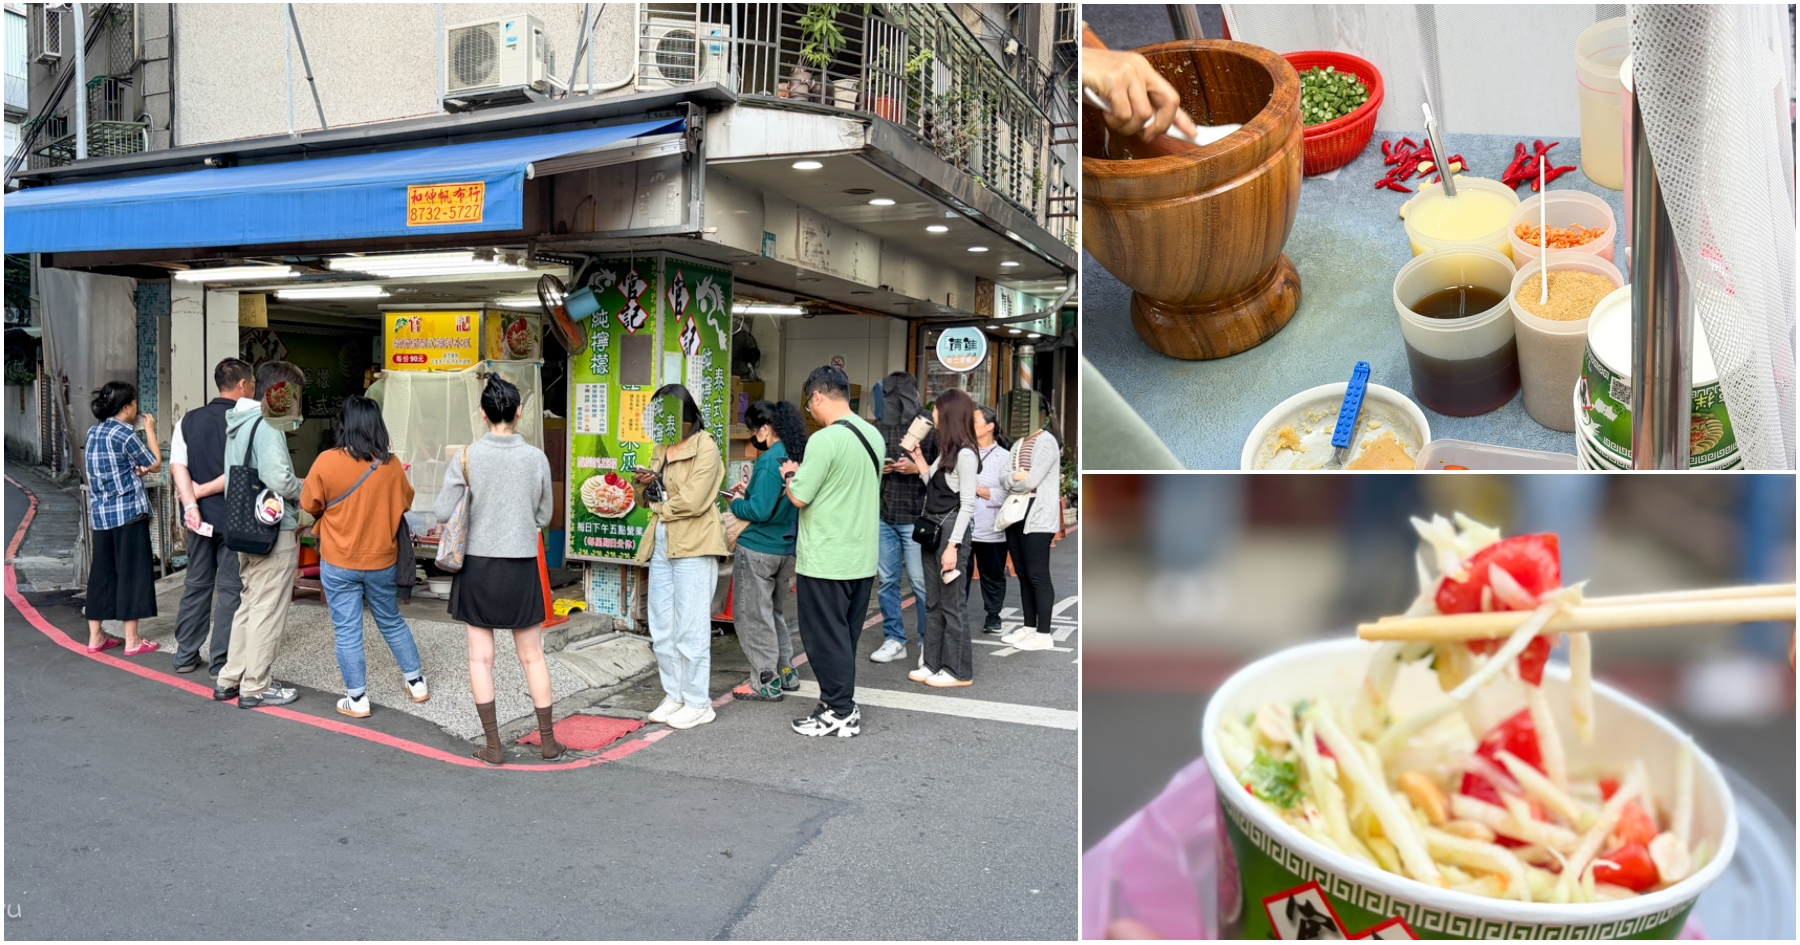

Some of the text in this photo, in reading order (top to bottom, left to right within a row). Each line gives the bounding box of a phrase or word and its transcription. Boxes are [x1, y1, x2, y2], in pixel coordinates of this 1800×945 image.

[410, 204, 480, 221] 8732-5727
[590, 308, 610, 375] 純檸檬
[577, 522, 644, 536] 每日下午五點營業
